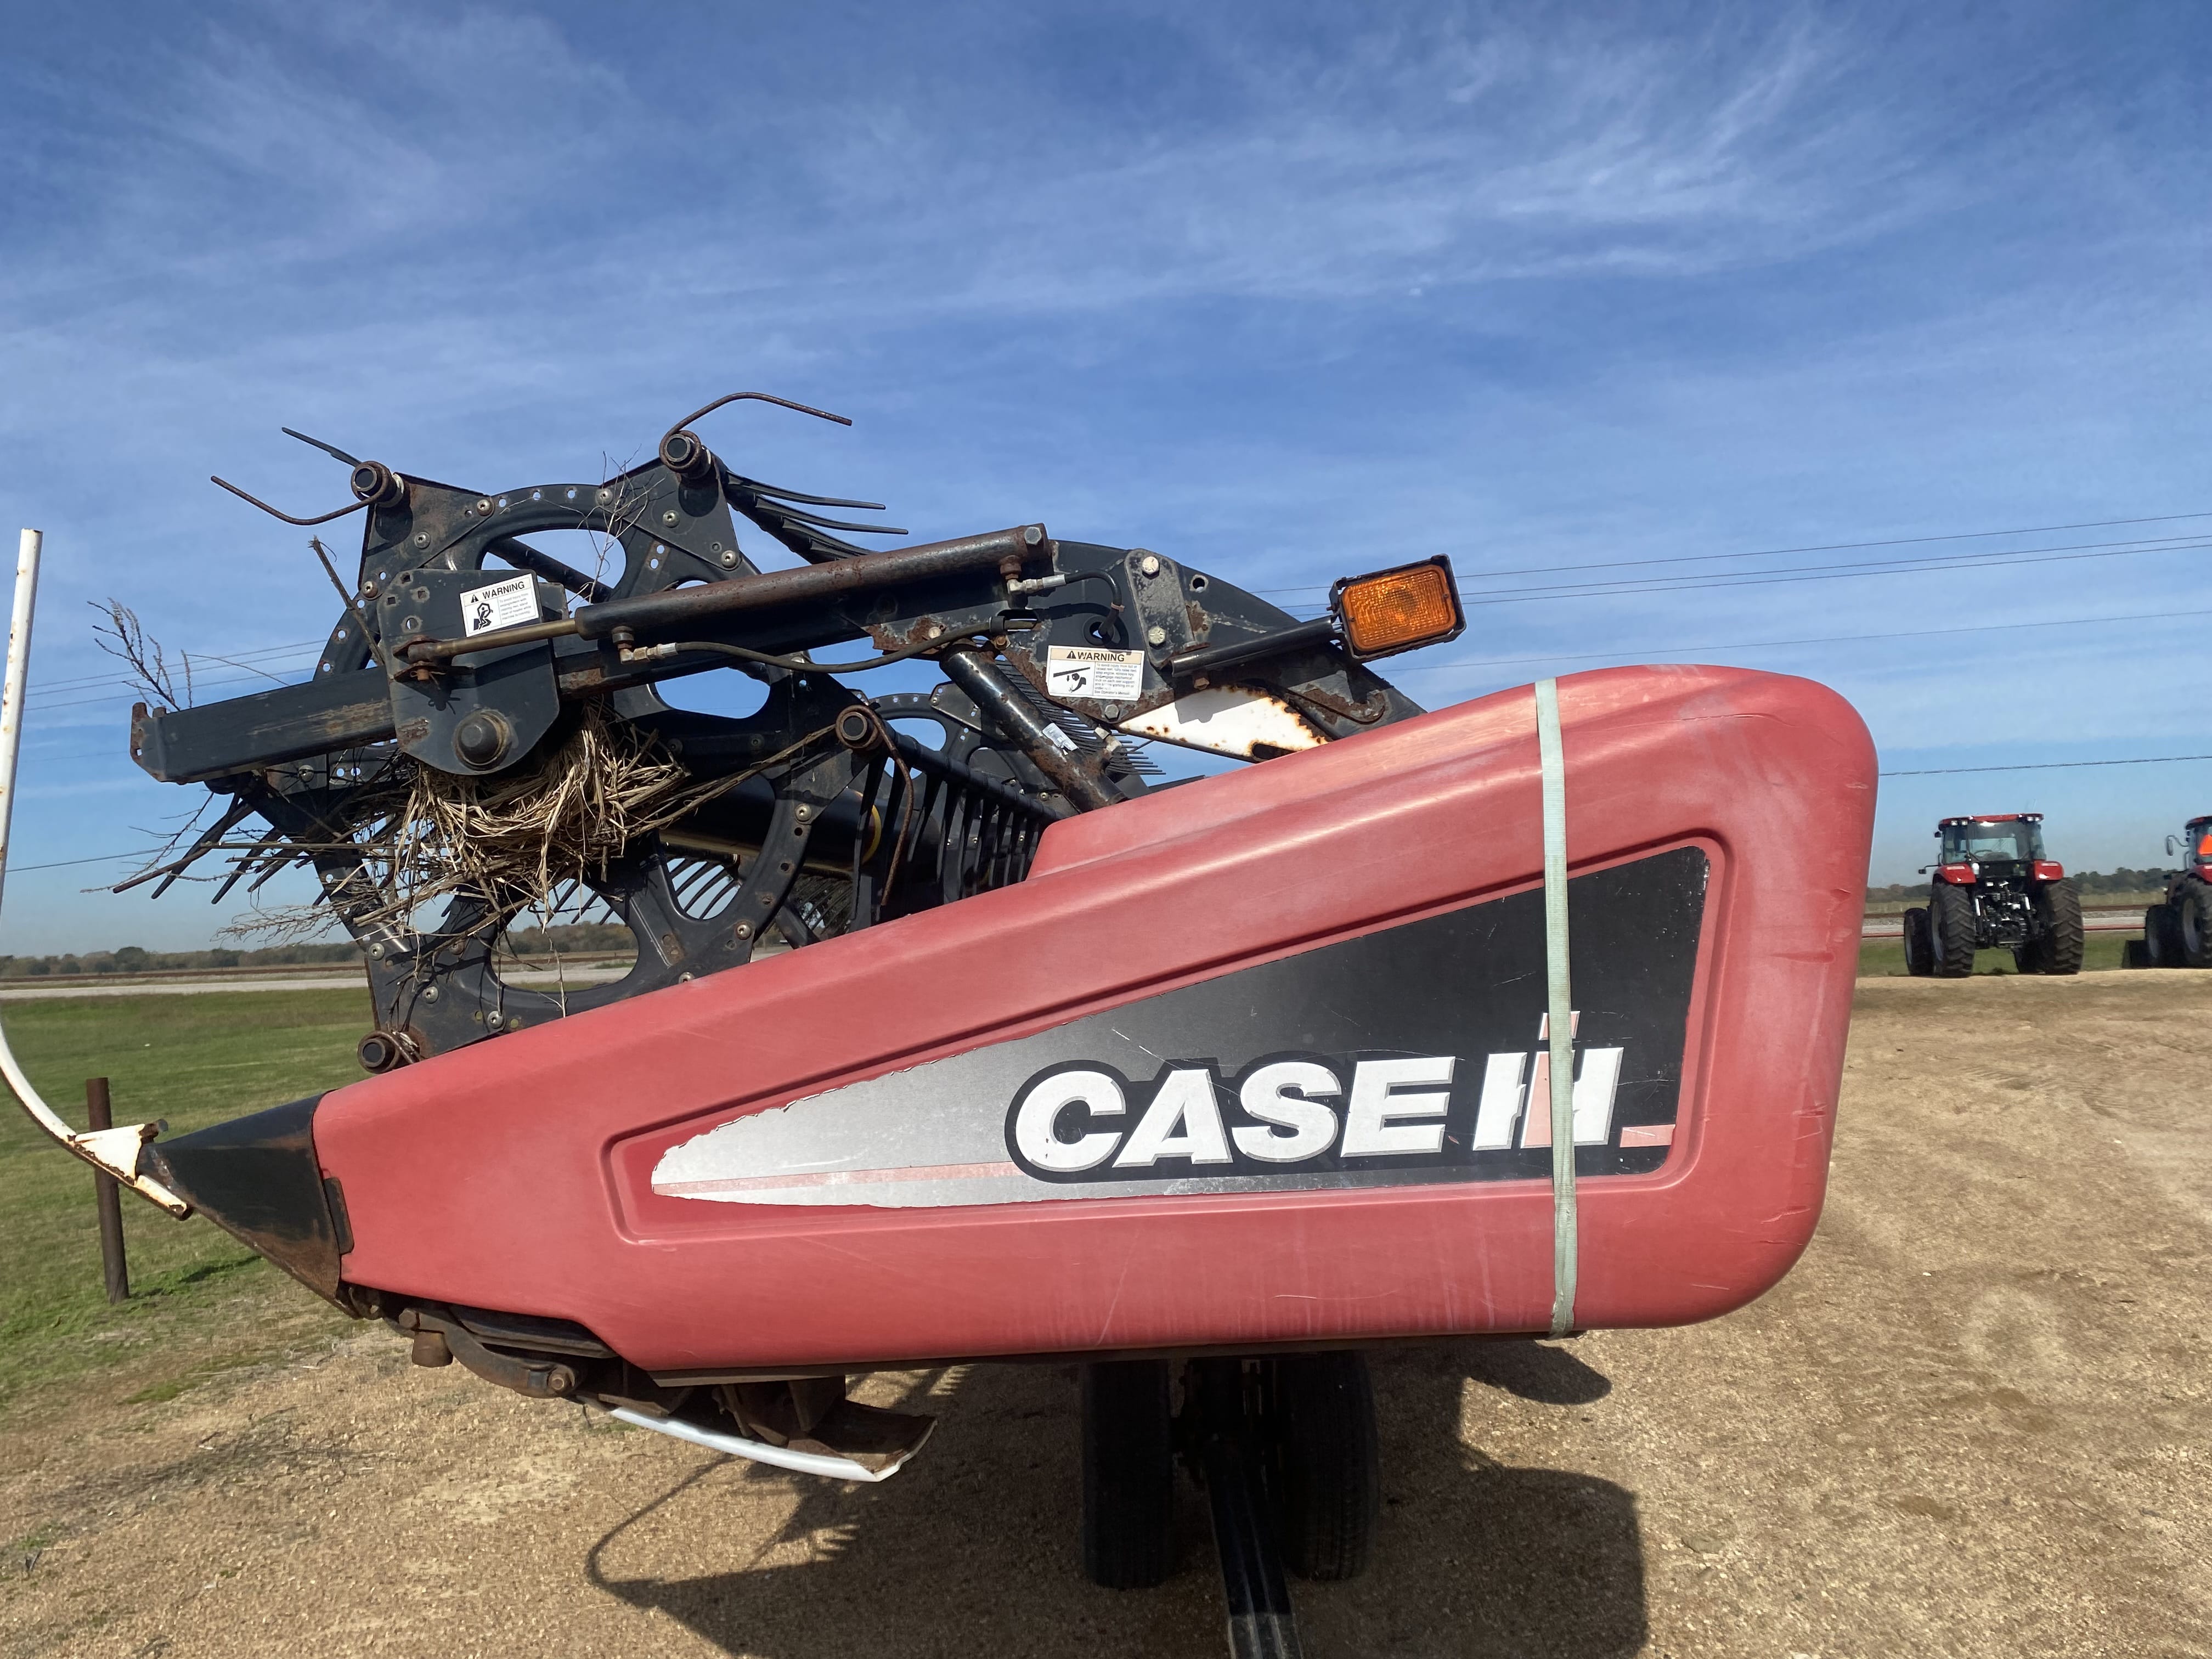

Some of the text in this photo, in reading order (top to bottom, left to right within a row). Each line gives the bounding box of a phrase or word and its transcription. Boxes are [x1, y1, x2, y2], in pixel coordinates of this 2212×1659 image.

[482, 582, 525, 600] WARNING
[1077, 651, 1125, 662] WARNING
[1015, 1056, 1457, 1172] CASE
